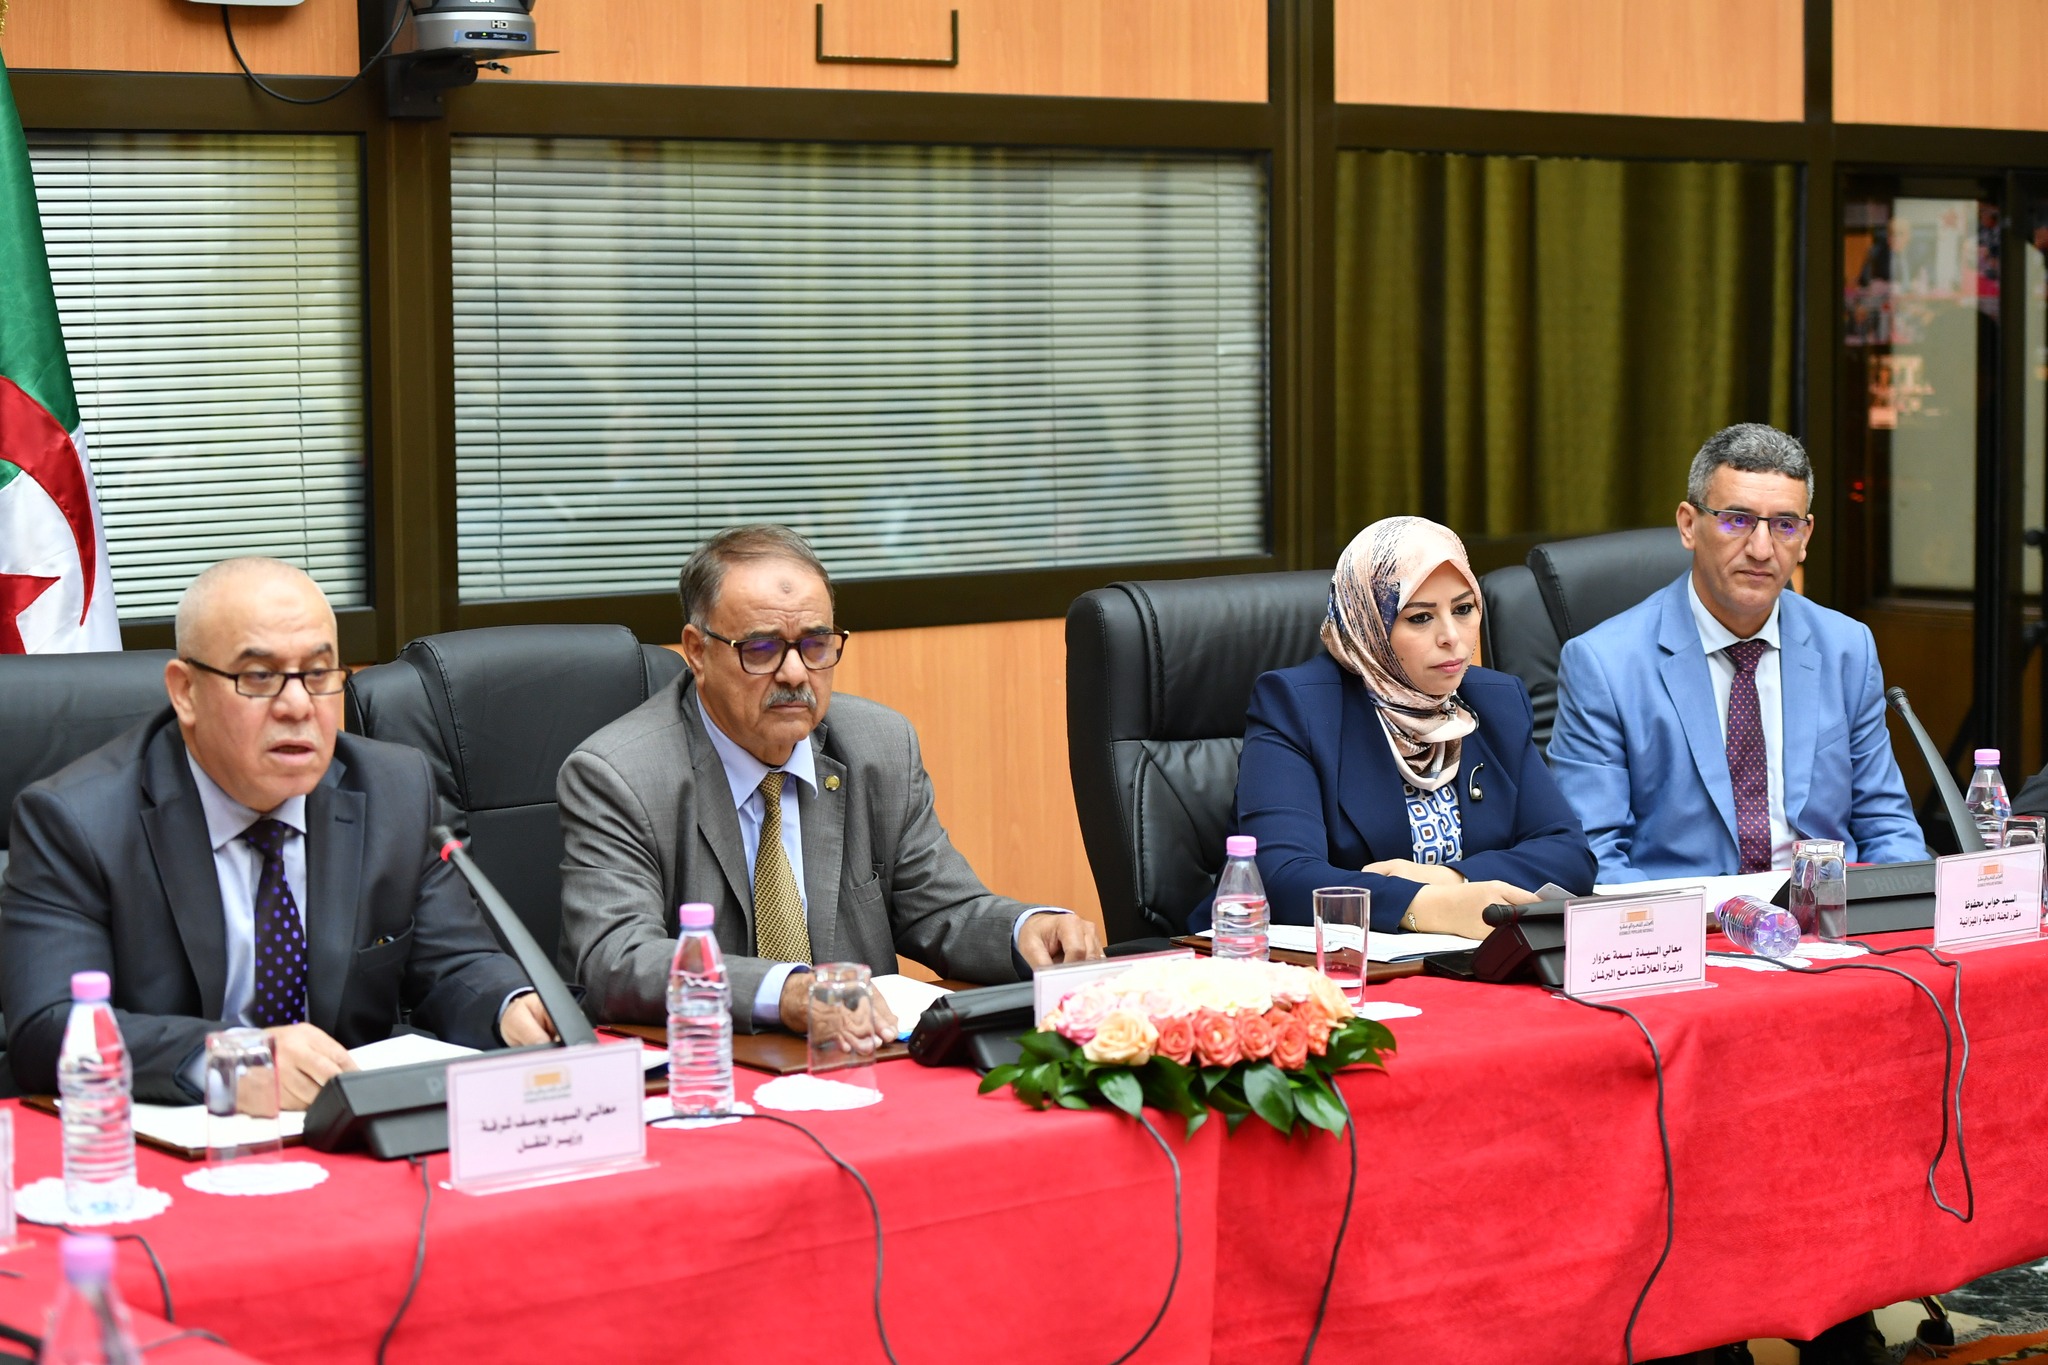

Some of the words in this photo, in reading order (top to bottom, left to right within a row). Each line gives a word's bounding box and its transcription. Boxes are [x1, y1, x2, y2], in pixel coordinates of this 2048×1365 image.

[491, 20, 509, 29] HD
[1965, 899, 1984, 911] محفوظ
[1985, 897, 2001, 909] حواس
[2002, 894, 2018, 906] السيد
[1613, 950, 1632, 961] بسمة
[1636, 946, 1662, 959] السيدة
[1662, 944, 1682, 958] معالي
[1592, 951, 1611, 965] عزوار
[1630, 963, 1662, 975] العلاقات
[1663, 960, 1683, 974] وزيرة
[1591, 968, 1616, 983] البرلمان
[1617, 969, 1629, 981] مع
[515, 1113, 548, 1129] يوسف
[551, 1106, 582, 1126] السيد
[554, 1129, 583, 1149] وزير
